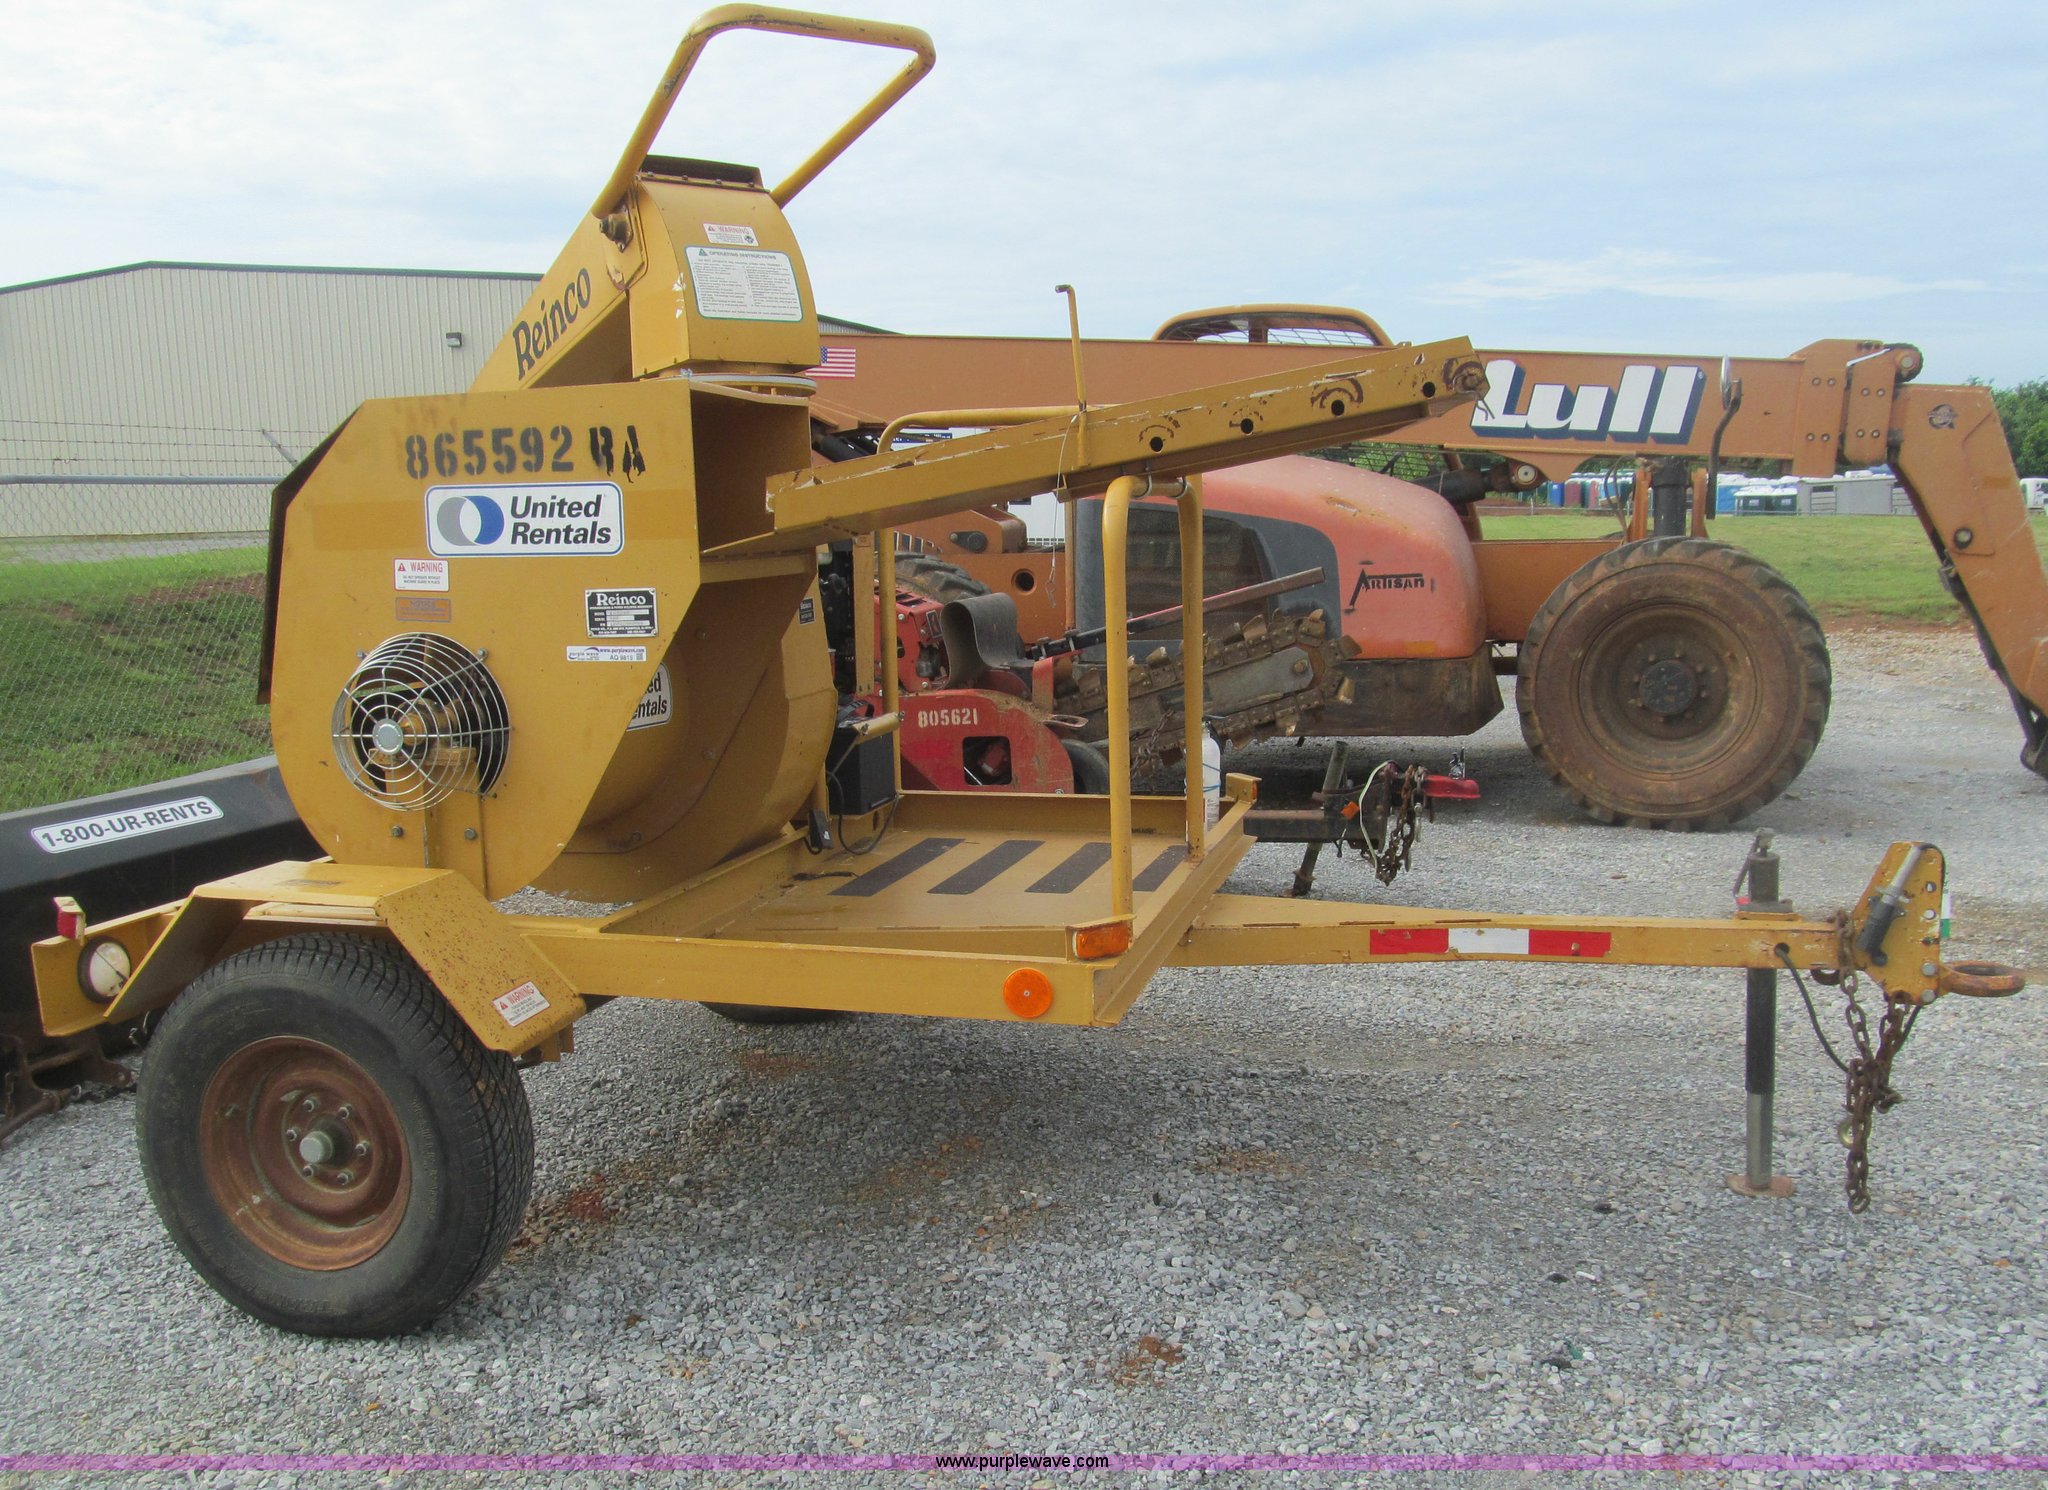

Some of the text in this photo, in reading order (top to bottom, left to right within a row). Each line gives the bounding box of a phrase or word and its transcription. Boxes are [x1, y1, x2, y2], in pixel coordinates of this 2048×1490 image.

[512, 267, 591, 381] Reinco
[1470, 359, 1708, 445] Lull
[405, 425, 574, 480] 865592
[510, 494, 602, 519] United
[510, 521, 612, 545] Rentals
[410, 561, 443, 573] WARNING
[596, 593, 647, 606] Reinco
[918, 708, 978, 728] 805621
[42, 801, 213, 847] 1-800-UR-RENTS
